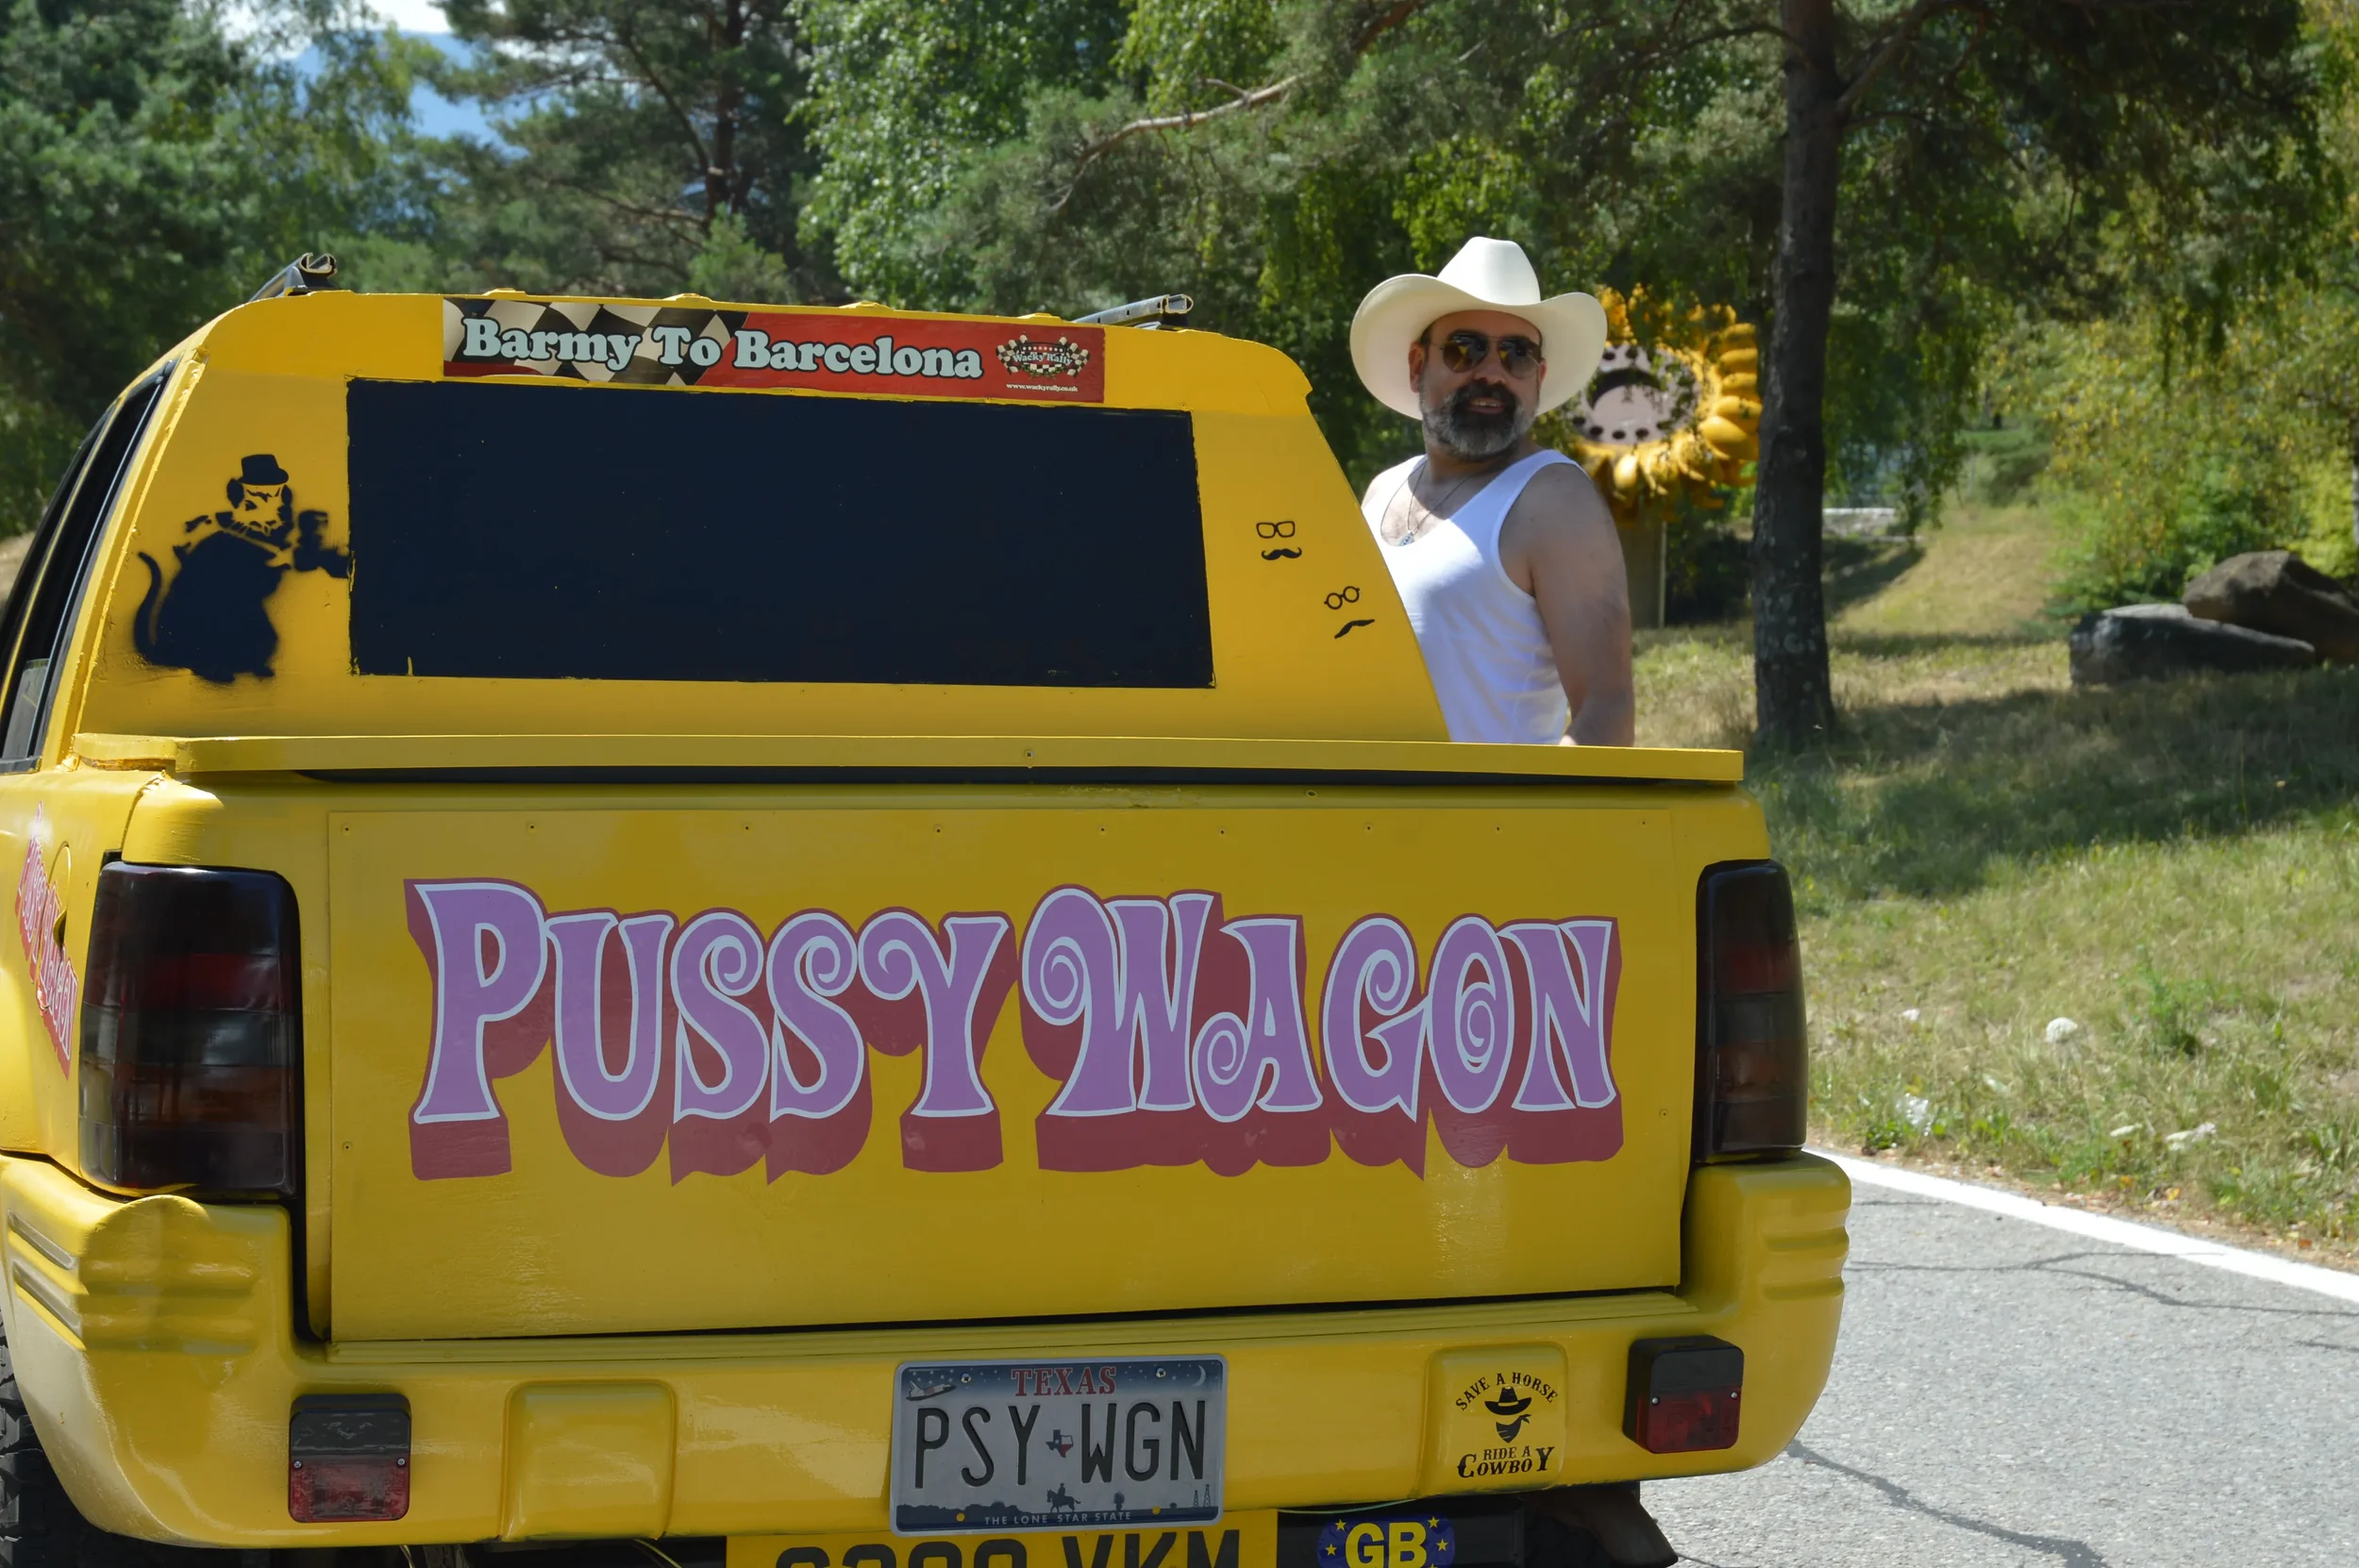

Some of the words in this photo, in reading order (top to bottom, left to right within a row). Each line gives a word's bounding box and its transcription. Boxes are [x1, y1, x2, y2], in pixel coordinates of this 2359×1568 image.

[461, 316, 643, 374] Barmy
[652, 325, 725, 368] To
[732, 328, 983, 380] Barcelona
[1013, 353, 1046, 362] Wacky
[1046, 354, 1073, 365] Rally
[1006, 383, 1078, 392] www.wackyrally.co.uk
[411, 878, 1012, 1125] PUSSY
[1021, 885, 1625, 1125] WAGON
[1011, 1366, 1117, 1396] TEXAS
[1455, 1376, 1490, 1410] SAVE
[1496, 1373, 1505, 1385] A
[1512, 1372, 1558, 1403] HORSE
[914, 1405, 1040, 1489] PSY
[1080, 1400, 1206, 1484] WGN
[1482, 1447, 1516, 1460] RIDE
[1521, 1445, 1531, 1457] A
[1457, 1446, 1555, 1478] COWBOY
[984, 1515, 1009, 1526] THE
[1013, 1514, 1048, 1525] LONE
[1057, 1513, 1088, 1523] STAR
[1095, 1511, 1131, 1522] STATE
[1345, 1521, 1428, 1568] GB
